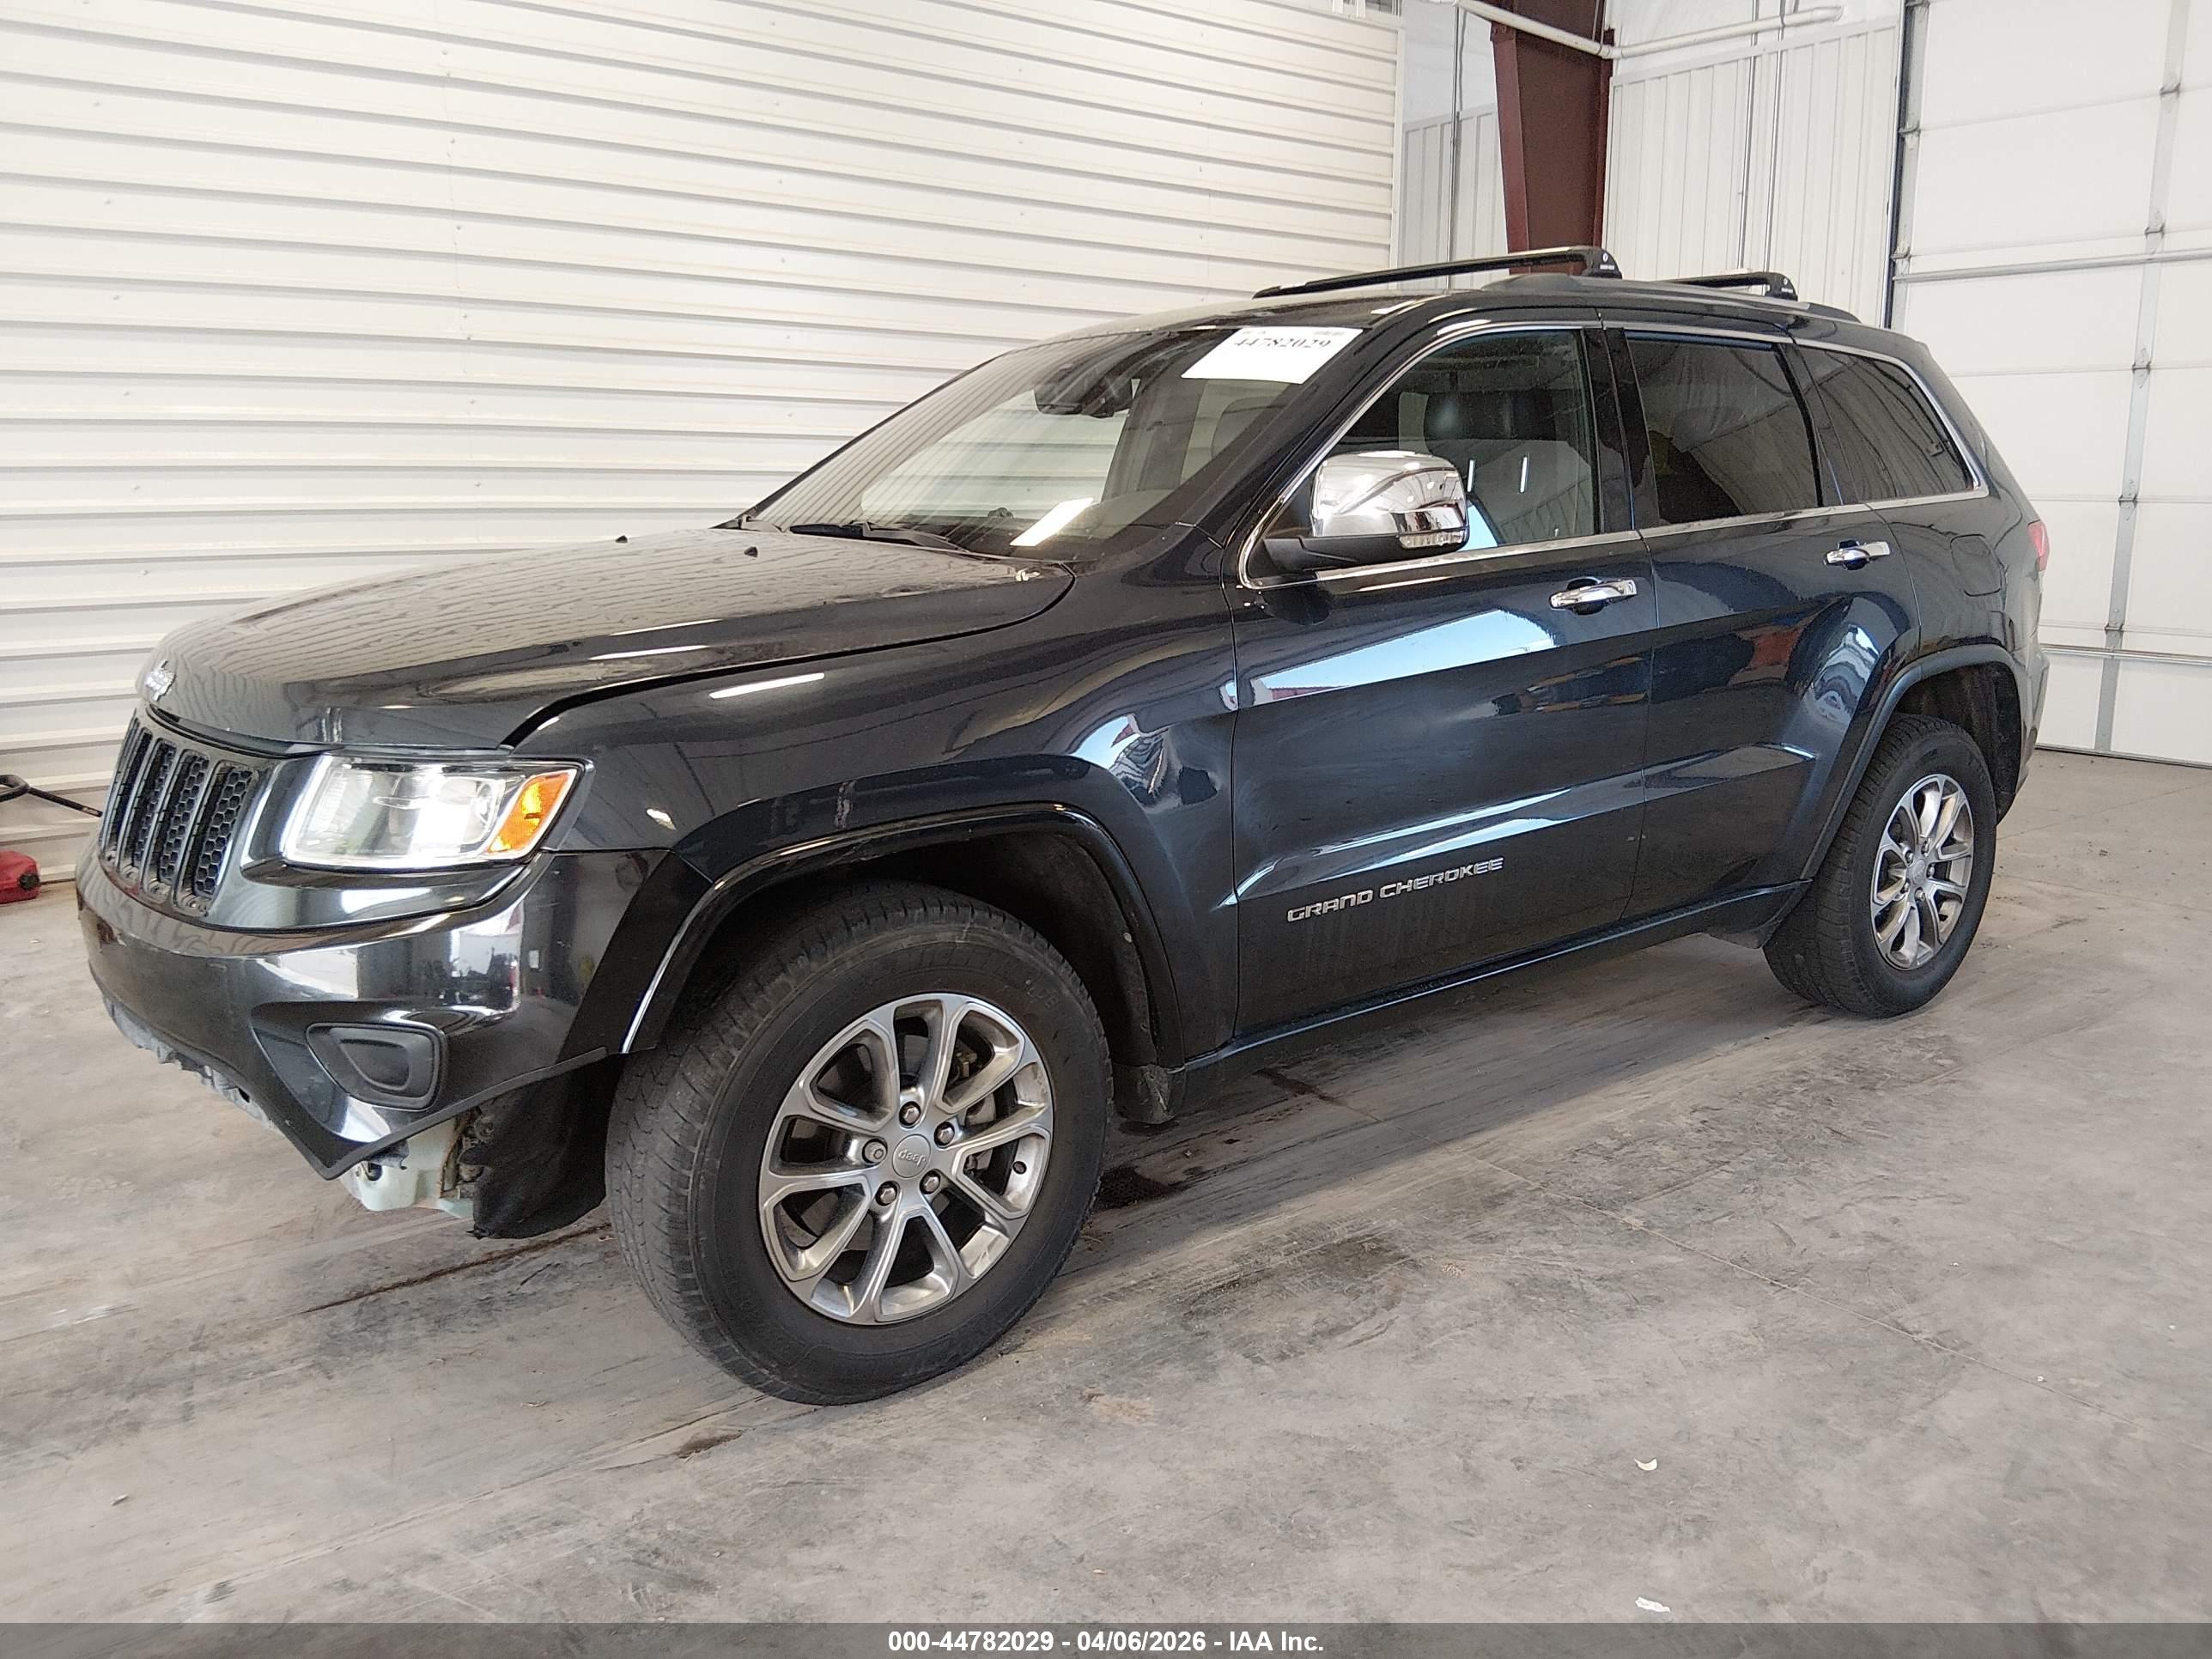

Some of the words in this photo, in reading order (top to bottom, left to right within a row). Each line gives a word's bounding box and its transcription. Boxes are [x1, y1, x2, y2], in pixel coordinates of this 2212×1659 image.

[1234, 337, 1332, 349] 44782029
[1287, 890, 1374, 923] GRAND
[1379, 857, 1504, 900] CHEROKEE
[897, 1149, 927, 1167] Jeep
